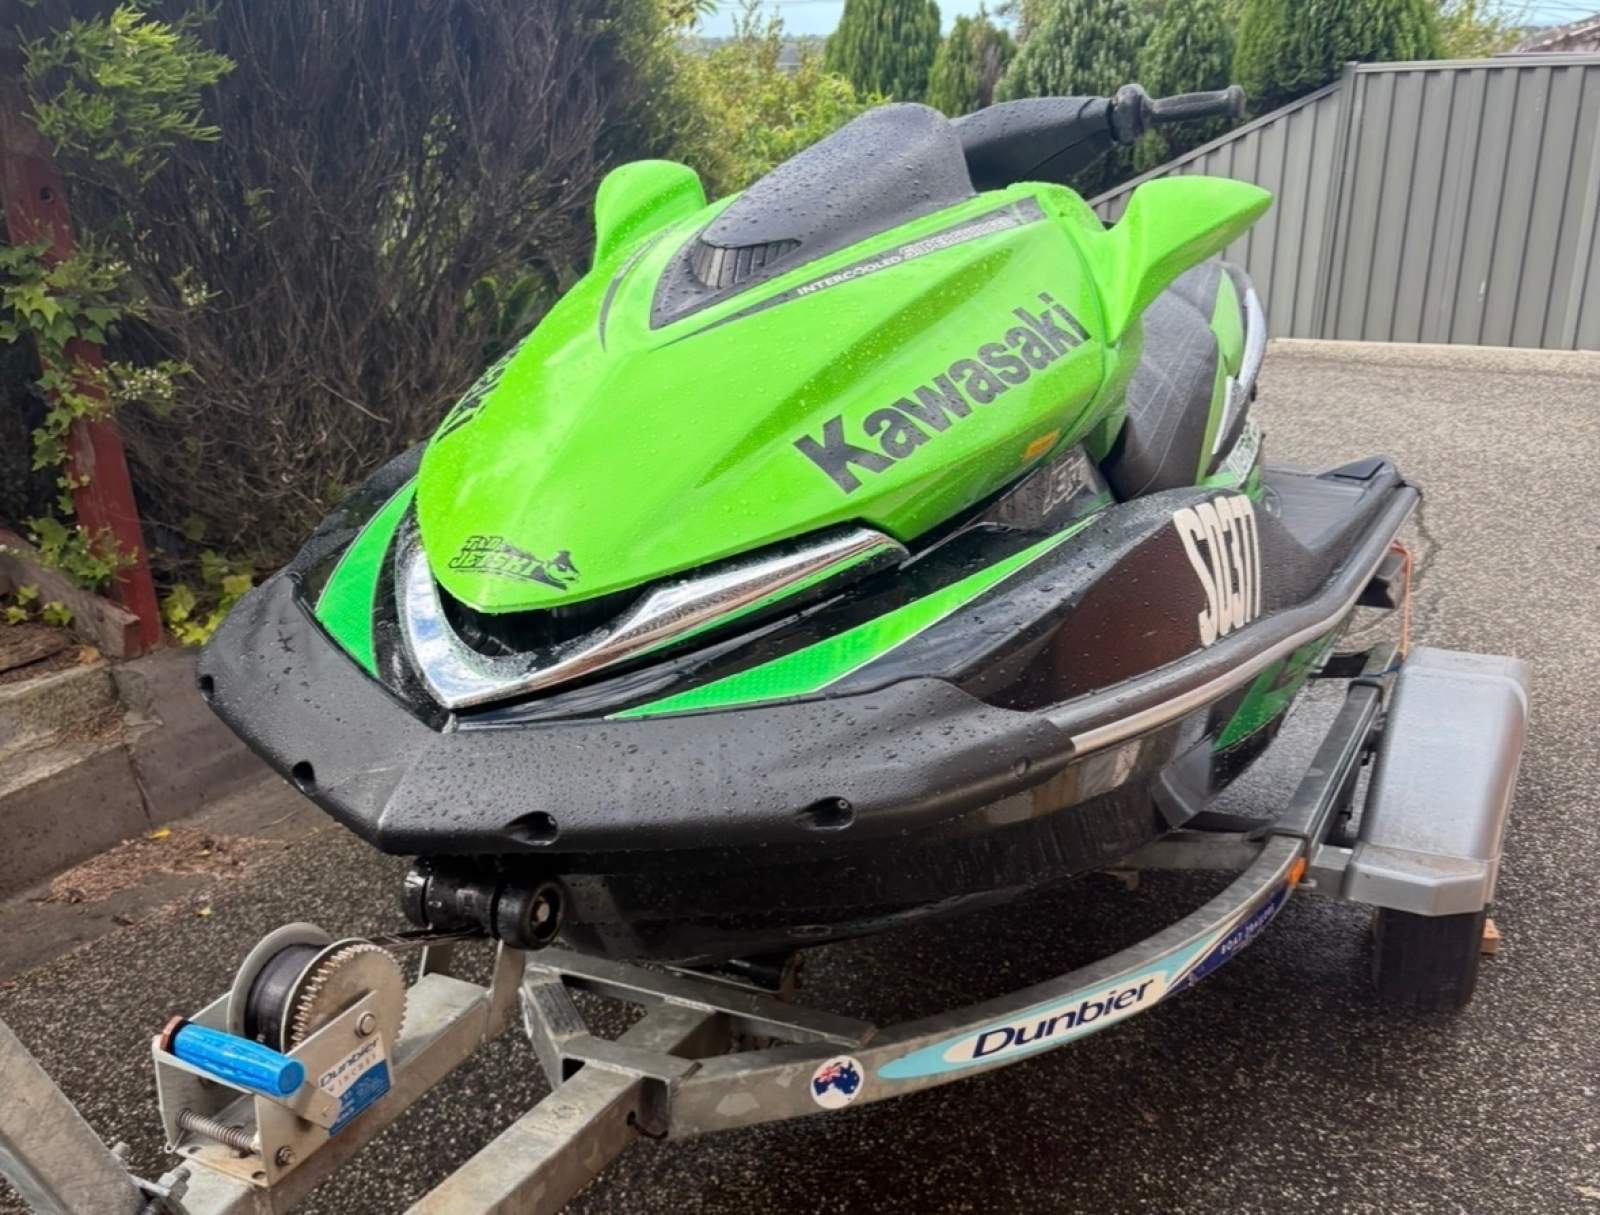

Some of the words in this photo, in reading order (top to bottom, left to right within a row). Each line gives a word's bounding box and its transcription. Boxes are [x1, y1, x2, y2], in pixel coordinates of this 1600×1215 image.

[797, 255, 902, 295] INTERCOOLED
[792, 292, 1091, 494] Kawasaki
[972, 979, 1155, 1059] Dunbier
